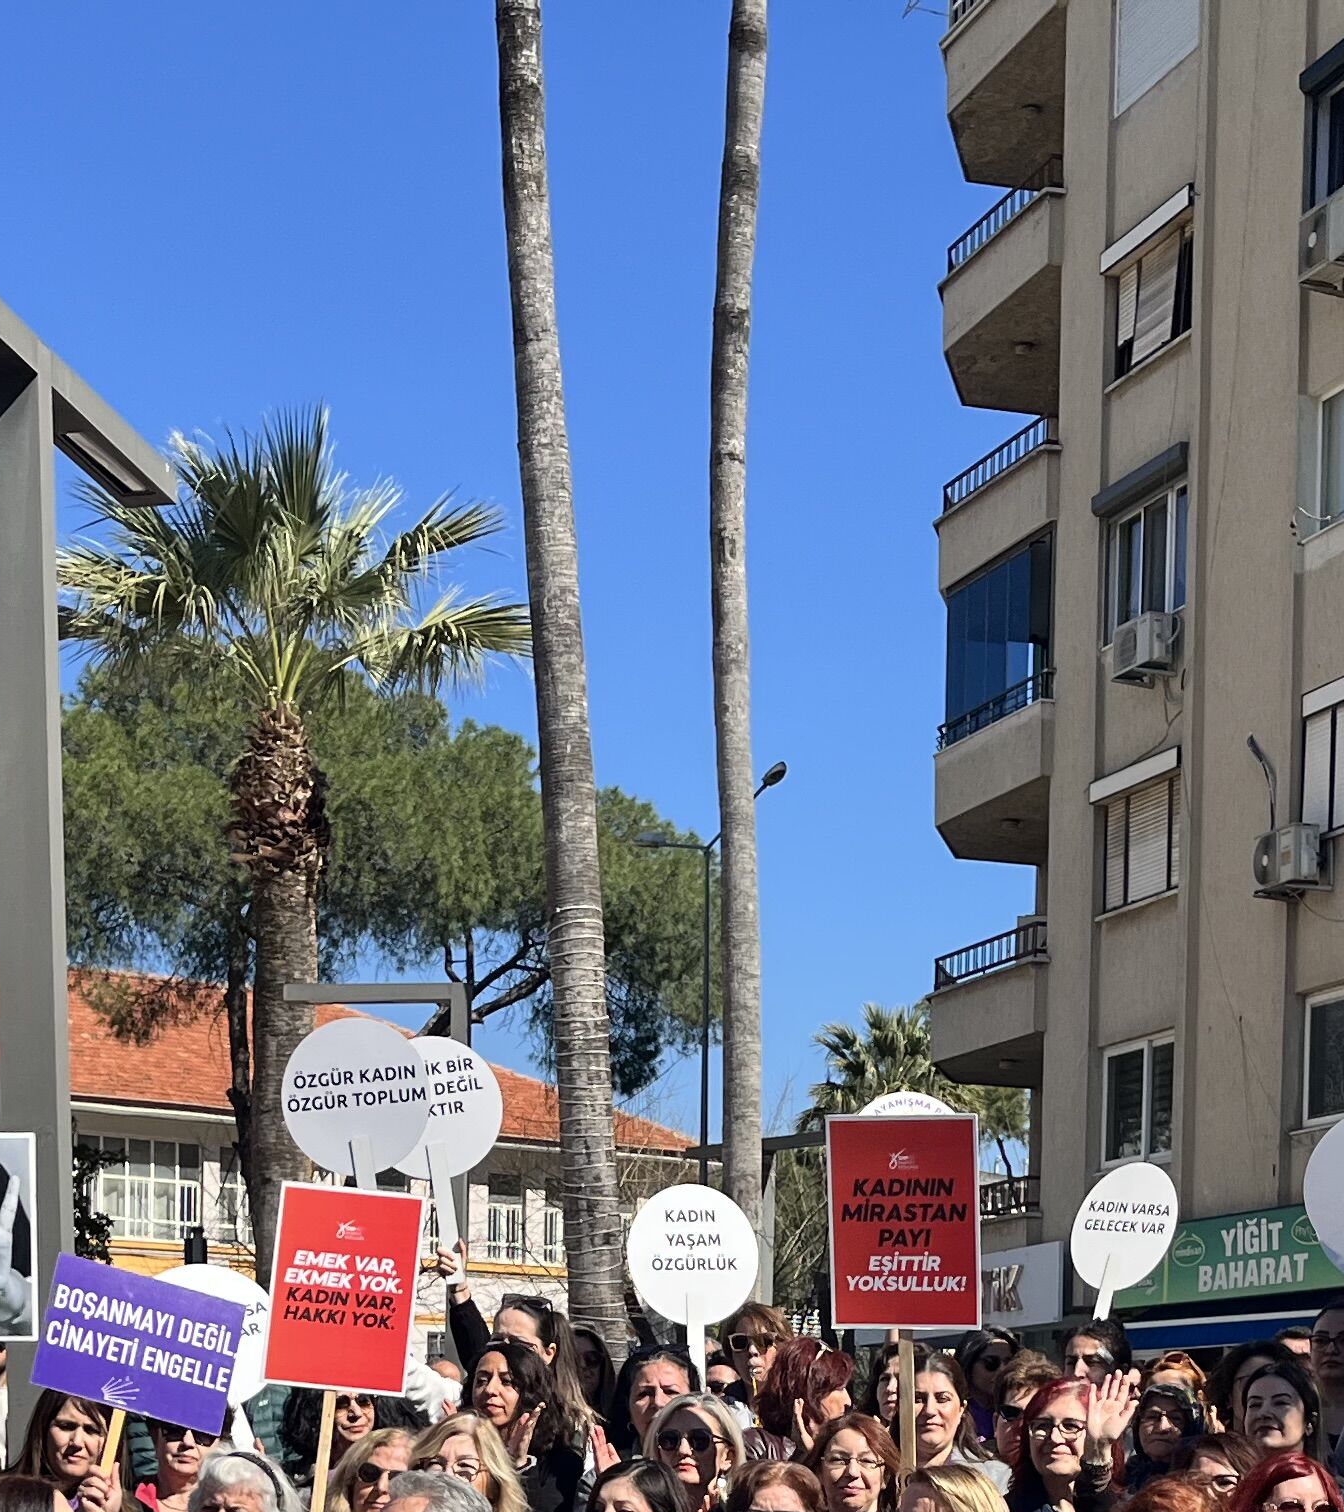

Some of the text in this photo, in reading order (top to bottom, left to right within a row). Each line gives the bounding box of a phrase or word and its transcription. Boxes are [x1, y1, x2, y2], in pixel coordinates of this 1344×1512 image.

[446, 1056, 474, 1073] BİR
[293, 1064, 416, 1090] ÖZGÜR KADIN
[434, 1075, 483, 1096] DEĞİL
[287, 1087, 427, 1113] ÖZGÜR TOPLUM
[874, 1098, 931, 1116] AYANIŞMA
[853, 1178, 954, 1198] KADININ
[664, 1209, 716, 1224] KADIN
[841, 1197, 968, 1223] MİRASTAN
[1088, 1200, 1170, 1217] KADIN VARSA
[878, 1228, 931, 1248] PAYI
[1084, 1219, 1165, 1235] GELECEK VAR
[1221, 1218, 1283, 1257] YİĞİT
[666, 1232, 721, 1251] YAŞAM
[293, 1249, 397, 1277] EMEK VAR,
[652, 1253, 738, 1272] ÖZGÜRLÜK
[868, 1252, 941, 1276] EŞİTTİR
[1198, 1252, 1309, 1293] BAHARAT
[283, 1267, 403, 1295] EKMEK YOK.
[846, 1275, 968, 1293] YOKSULLUK!
[286, 1287, 397, 1313] KADIN VAR,
[53, 1283, 239, 1358] BOŞANMAYI DEĞİL,
[283, 1305, 395, 1331] HAKKI YOK.
[45, 1320, 231, 1393] CİNAYETİ ENGELLE
